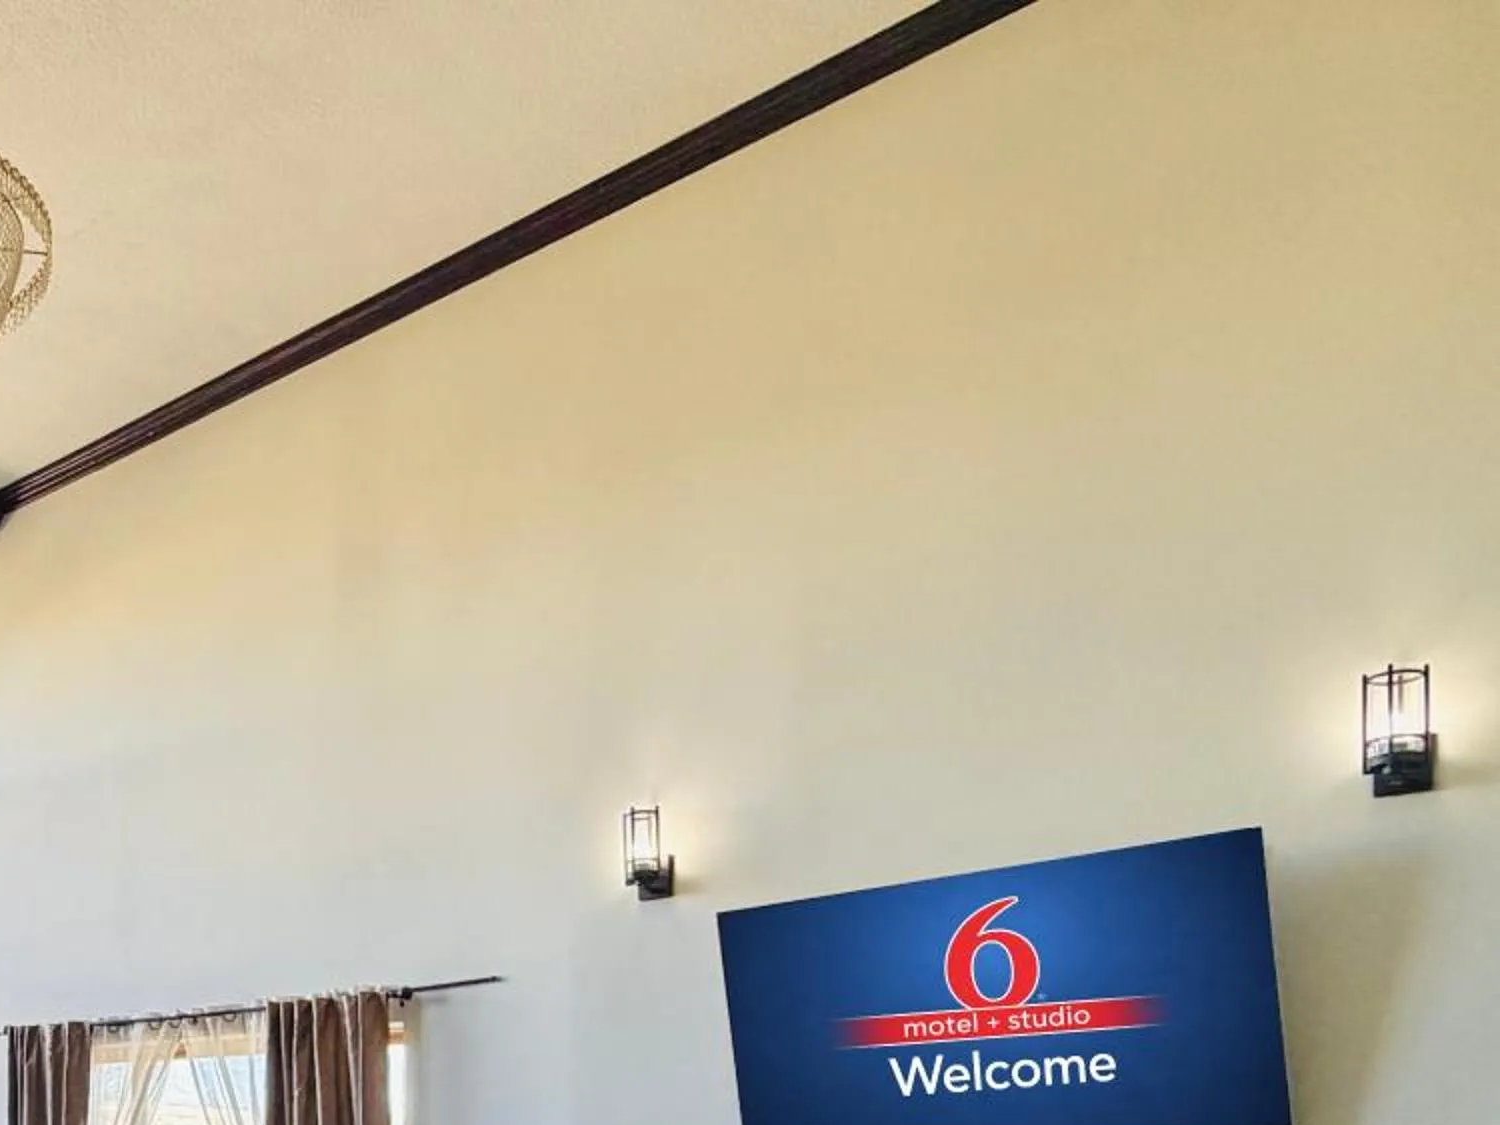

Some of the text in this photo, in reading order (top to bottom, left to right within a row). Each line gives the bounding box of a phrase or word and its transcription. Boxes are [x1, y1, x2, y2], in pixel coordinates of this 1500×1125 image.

[944, 895, 1041, 1009] 6
[903, 1006, 1091, 1038] motel + studio
[888, 1050, 1117, 1097] Welcome
